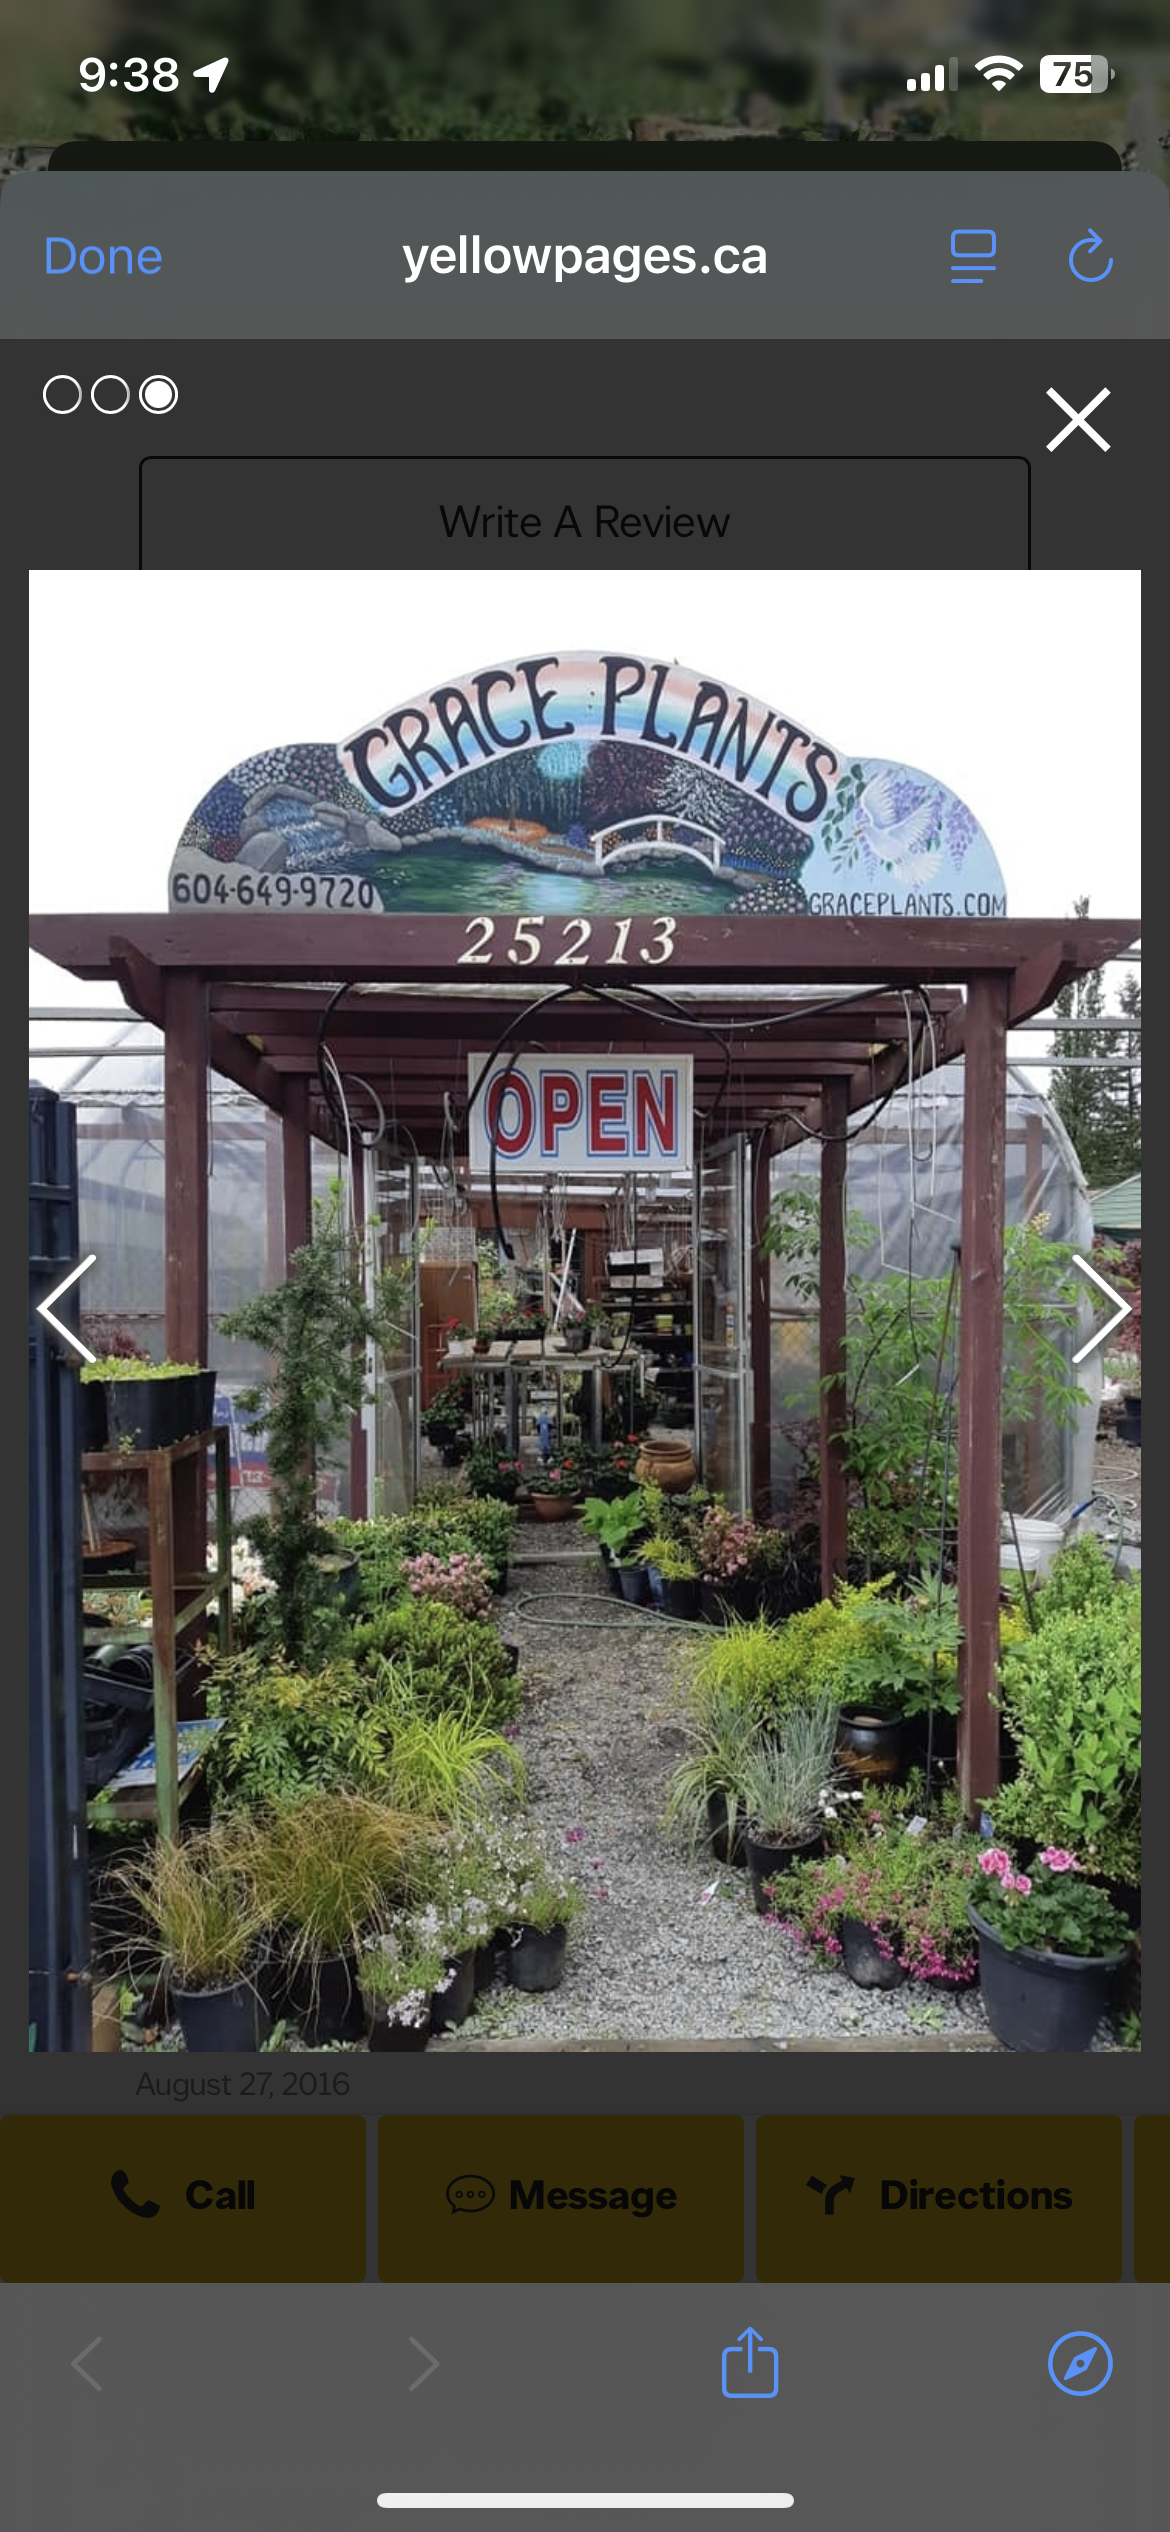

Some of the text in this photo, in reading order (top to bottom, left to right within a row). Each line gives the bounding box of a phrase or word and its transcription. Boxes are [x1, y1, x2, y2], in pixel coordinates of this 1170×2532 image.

[80, 58, 178, 93] 9:38
[1053, 61, 1093, 88] 75
[46, 237, 162, 274] Done
[402, 235, 767, 284] yellowpages.ca
[440, 505, 730, 537] Write A Review
[344, 656, 838, 823] GRACE PLANTS
[172, 872, 374, 909] 604-649-9720
[808, 892, 1007, 917] GRACEPLANTS.COM
[457, 916, 678, 966] 25213
[486, 1068, 679, 1158] OPEN
[135, 2072, 351, 2103] August 27, 2016
[186, 2179, 255, 2210] Call
[510, 2180, 678, 2218] Message
[881, 2179, 1073, 2210] Directions
